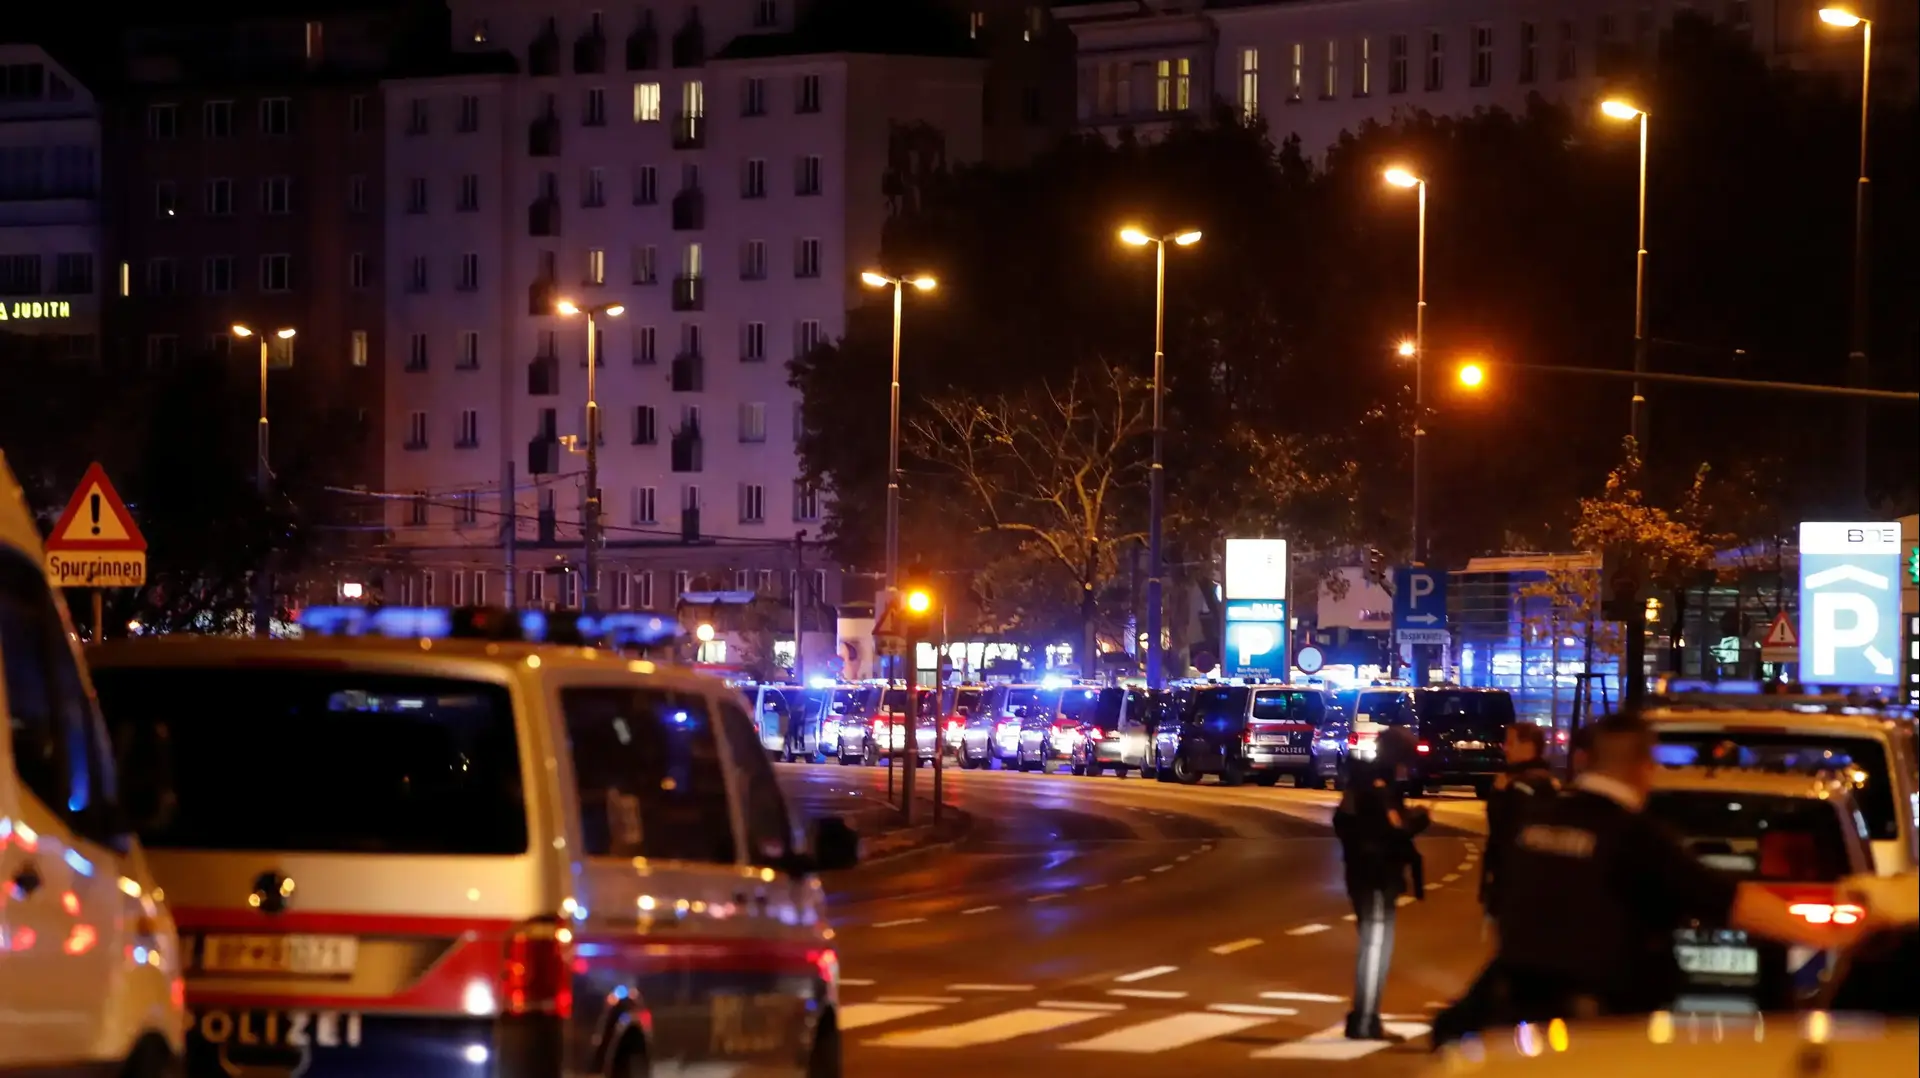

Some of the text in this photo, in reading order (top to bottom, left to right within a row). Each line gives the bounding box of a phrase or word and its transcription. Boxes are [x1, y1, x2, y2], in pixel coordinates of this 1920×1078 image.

[12, 301, 70, 318] JUDITH
[50, 556, 142, 582] Spurrinnen
[1410, 574, 1434, 609] P
[1238, 625, 1273, 666] P
[1813, 592, 1879, 676] P
[1275, 746, 1306, 754] POLIZEI
